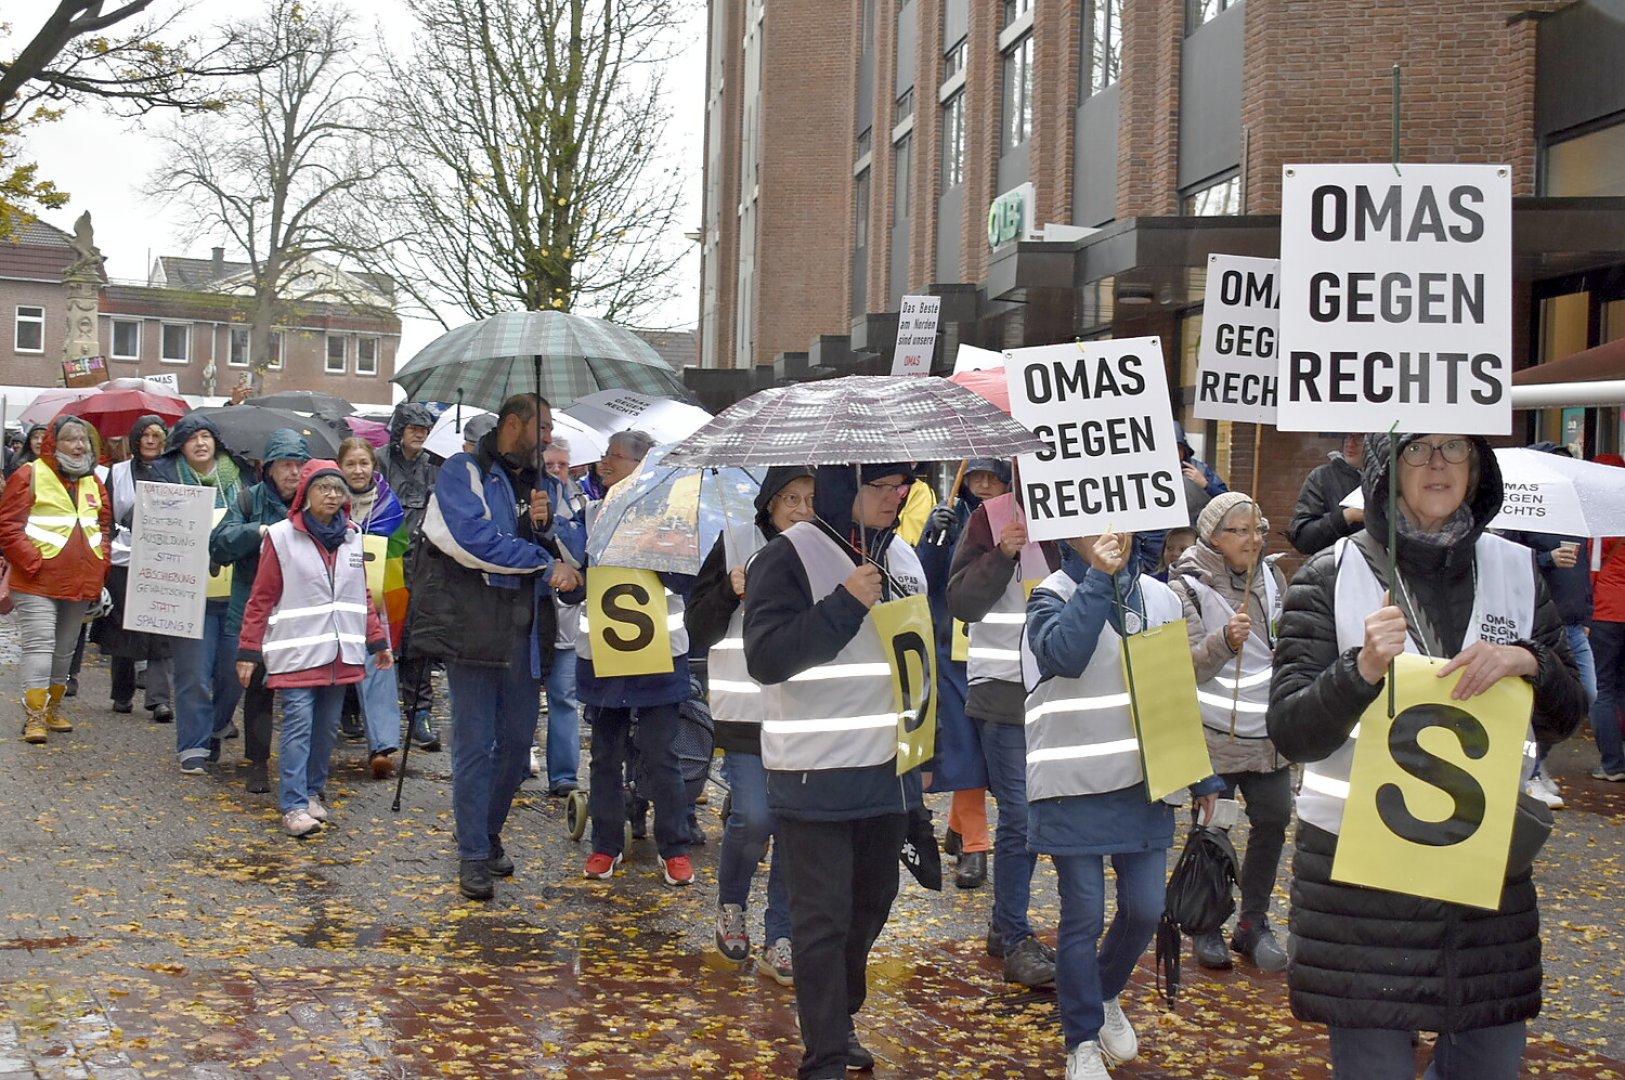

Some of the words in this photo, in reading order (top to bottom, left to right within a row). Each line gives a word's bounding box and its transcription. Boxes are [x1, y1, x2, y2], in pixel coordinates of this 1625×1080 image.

[988, 192, 1022, 247] OLB
[1310, 184, 1485, 243] OMAS
[902, 301, 916, 314] Das
[919, 302, 938, 314] Beste
[1220, 269, 1281, 310] OM
[1308, 272, 1486, 325] GEGEN
[898, 334, 912, 346] sind
[912, 336, 934, 346] unsere
[900, 320, 910, 330] am
[913, 318, 936, 330] Norden
[1215, 323, 1280, 360] GEG
[904, 355, 922, 366] OMAS
[1023, 354, 1146, 405] OMAS
[1289, 351, 1503, 406] RECHTS
[604, 402, 641, 417] RECHTS
[614, 398, 648, 412] GEGEN
[624, 396, 652, 407] OMAS
[1032, 416, 1156, 462] GEGEN
[1027, 470, 1176, 520] RECHTS
[898, 576, 918, 584] OPAS
[601, 583, 655, 652] S
[1486, 614, 1516, 629] OMS
[892, 630, 932, 734] D
[1375, 703, 1490, 847] S
